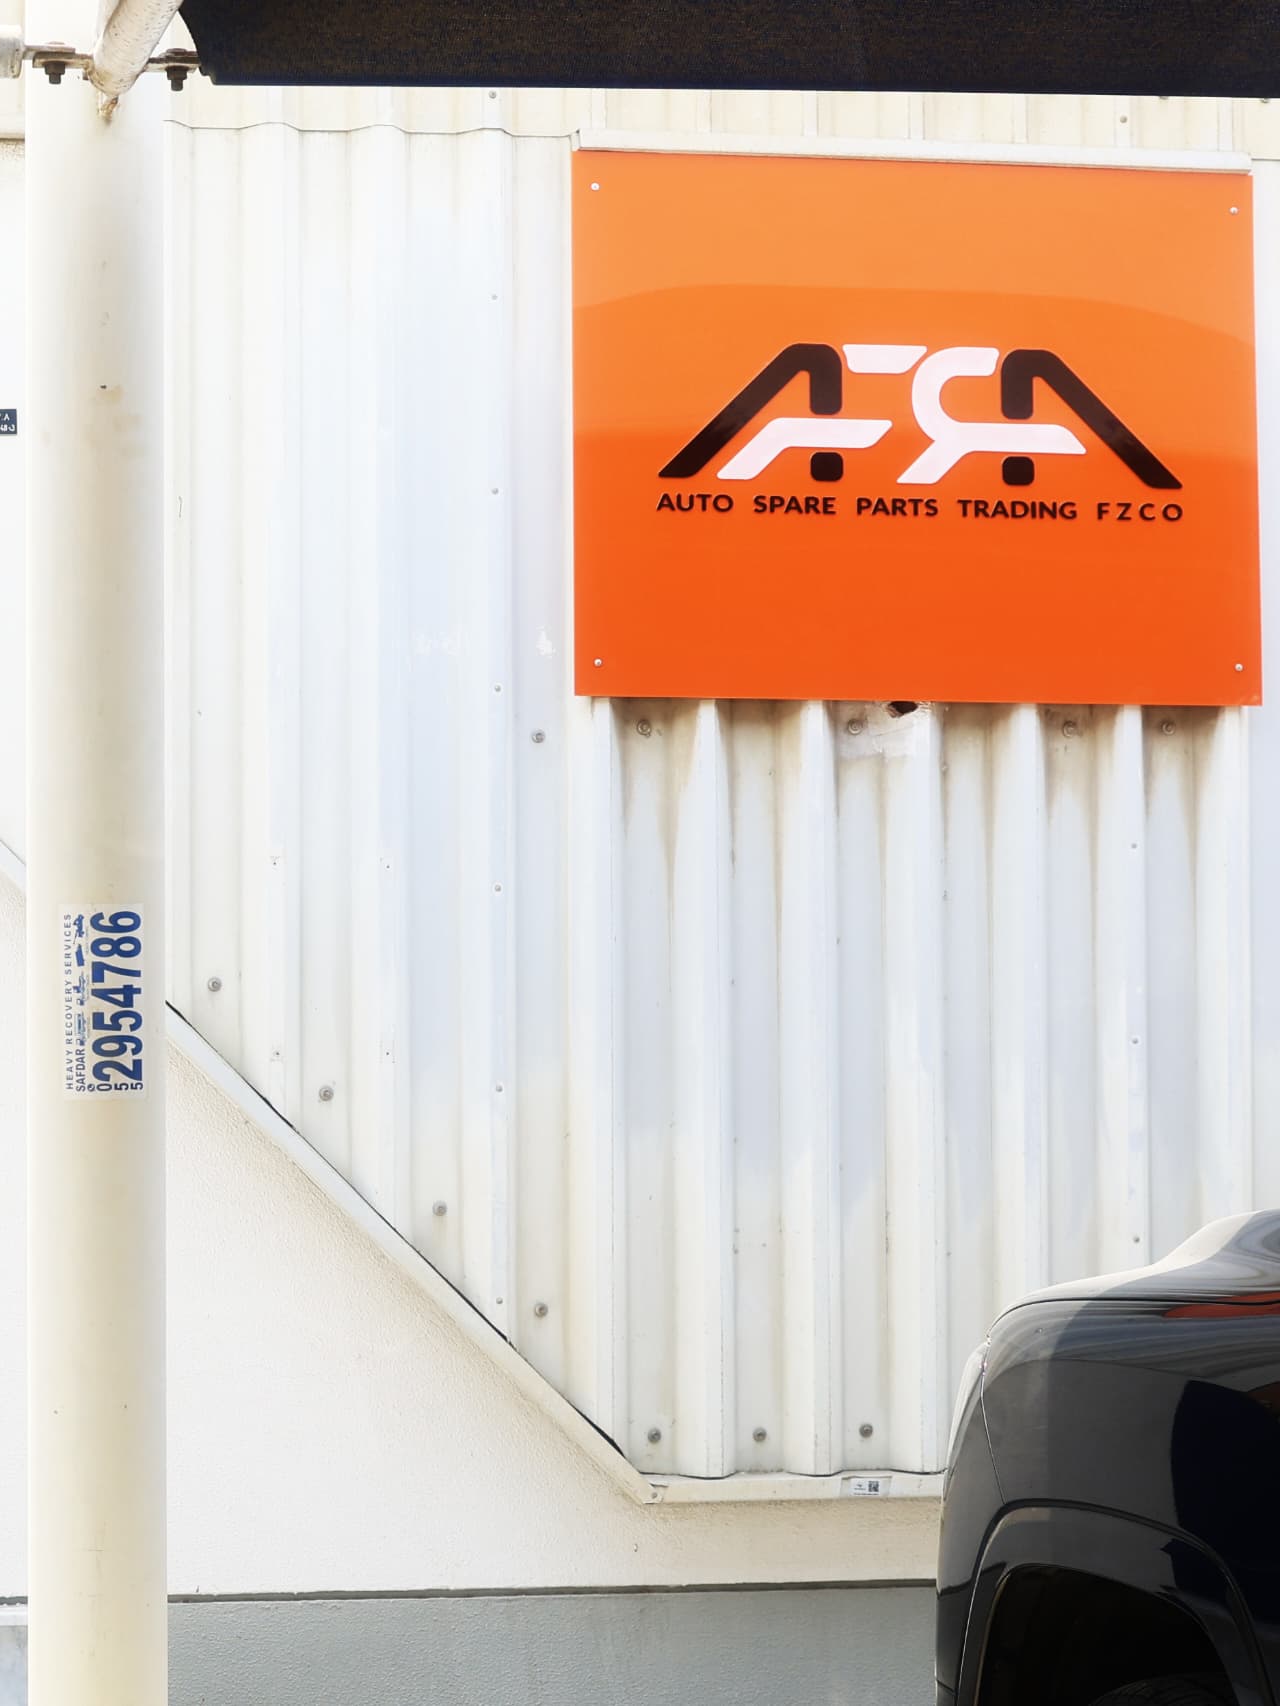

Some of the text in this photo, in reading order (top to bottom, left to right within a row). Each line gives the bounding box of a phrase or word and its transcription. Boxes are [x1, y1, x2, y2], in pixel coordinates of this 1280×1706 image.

[656, 492, 734, 513] AUTO
[753, 494, 837, 515] SPARE
[856, 497, 939, 517] PARTS
[957, 499, 1077, 519] TRADING
[63, 914, 74, 1090] HEAVY RECOVERY SERVICES
[90, 911, 144, 1082] 2954786
[75, 1048, 87, 1092] SAFDAR
